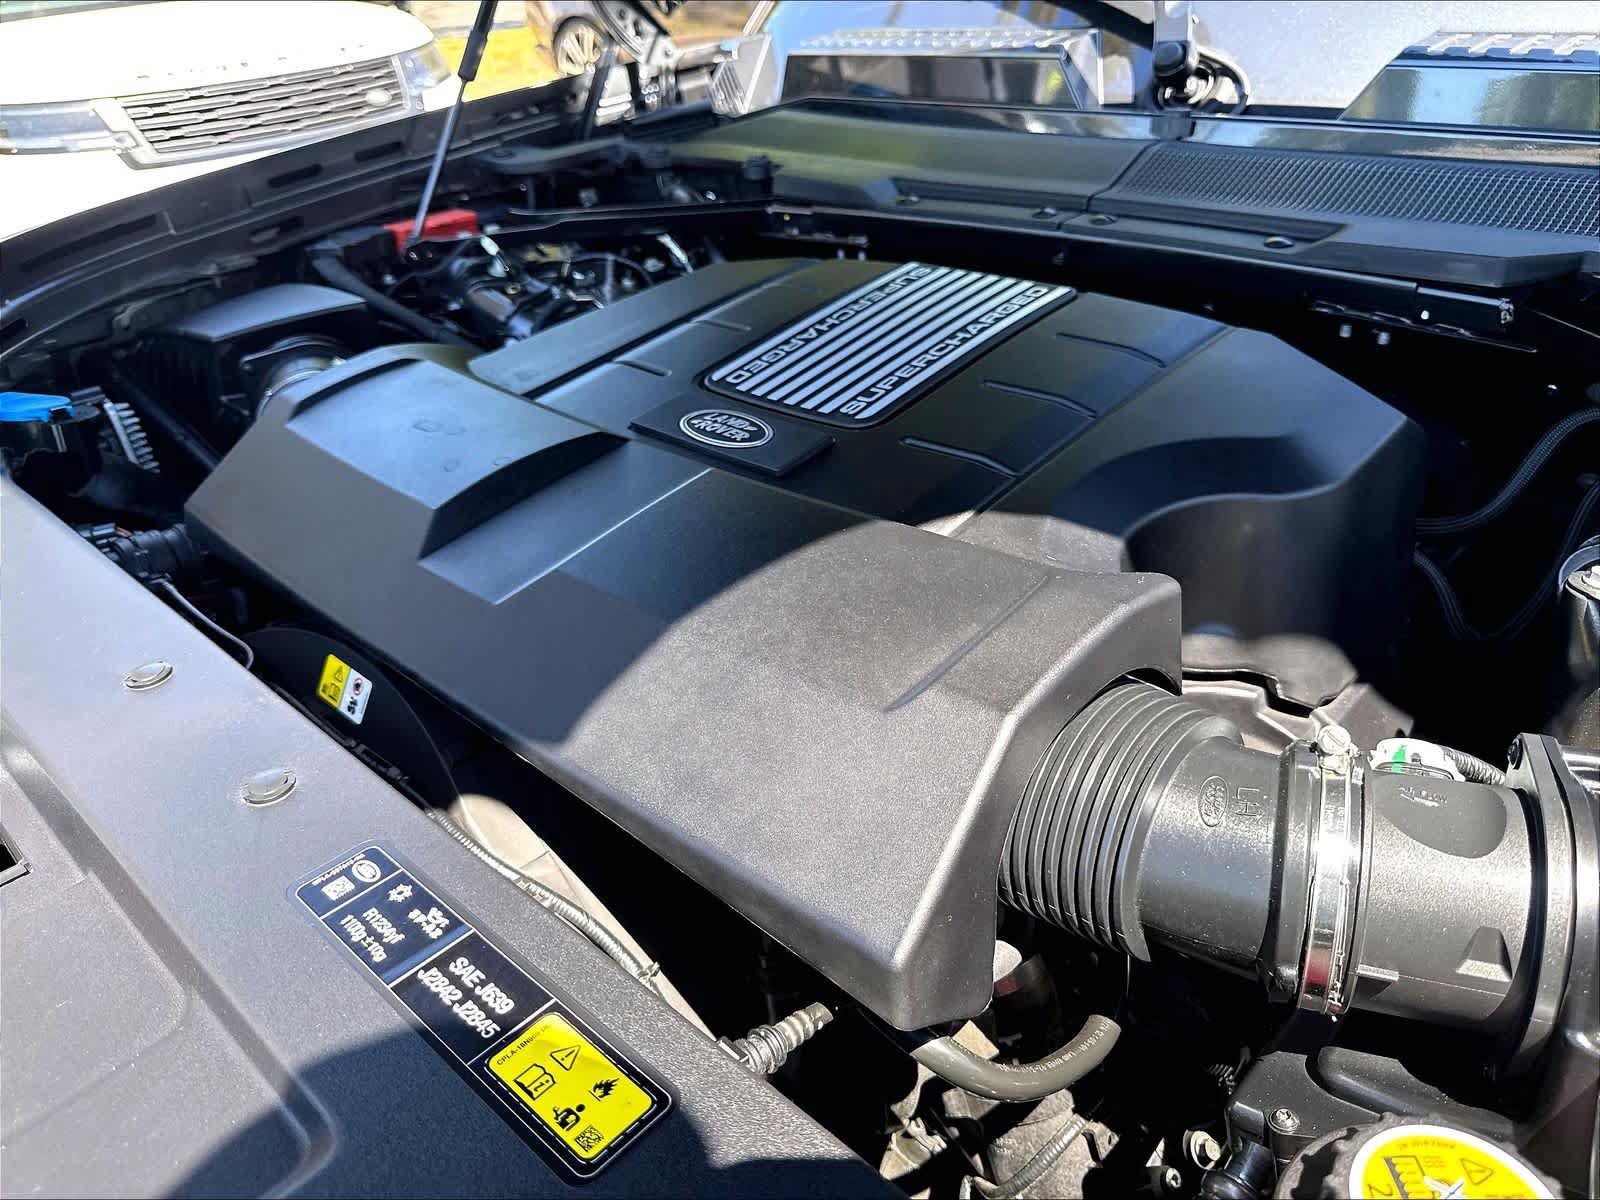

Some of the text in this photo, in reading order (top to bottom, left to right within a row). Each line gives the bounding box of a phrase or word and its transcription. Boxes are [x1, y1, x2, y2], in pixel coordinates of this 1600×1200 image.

[725, 266, 933, 384] SUPERCHARGED
[838, 285, 1050, 416] SUPERCHARGED
[693, 420, 752, 441] ROVER
[703, 413, 750, 430] LAND
[362, 906, 406, 945] R1234yf
[417, 966, 501, 1039] J2842 J2845
[448, 956, 515, 1015] SAE J639
